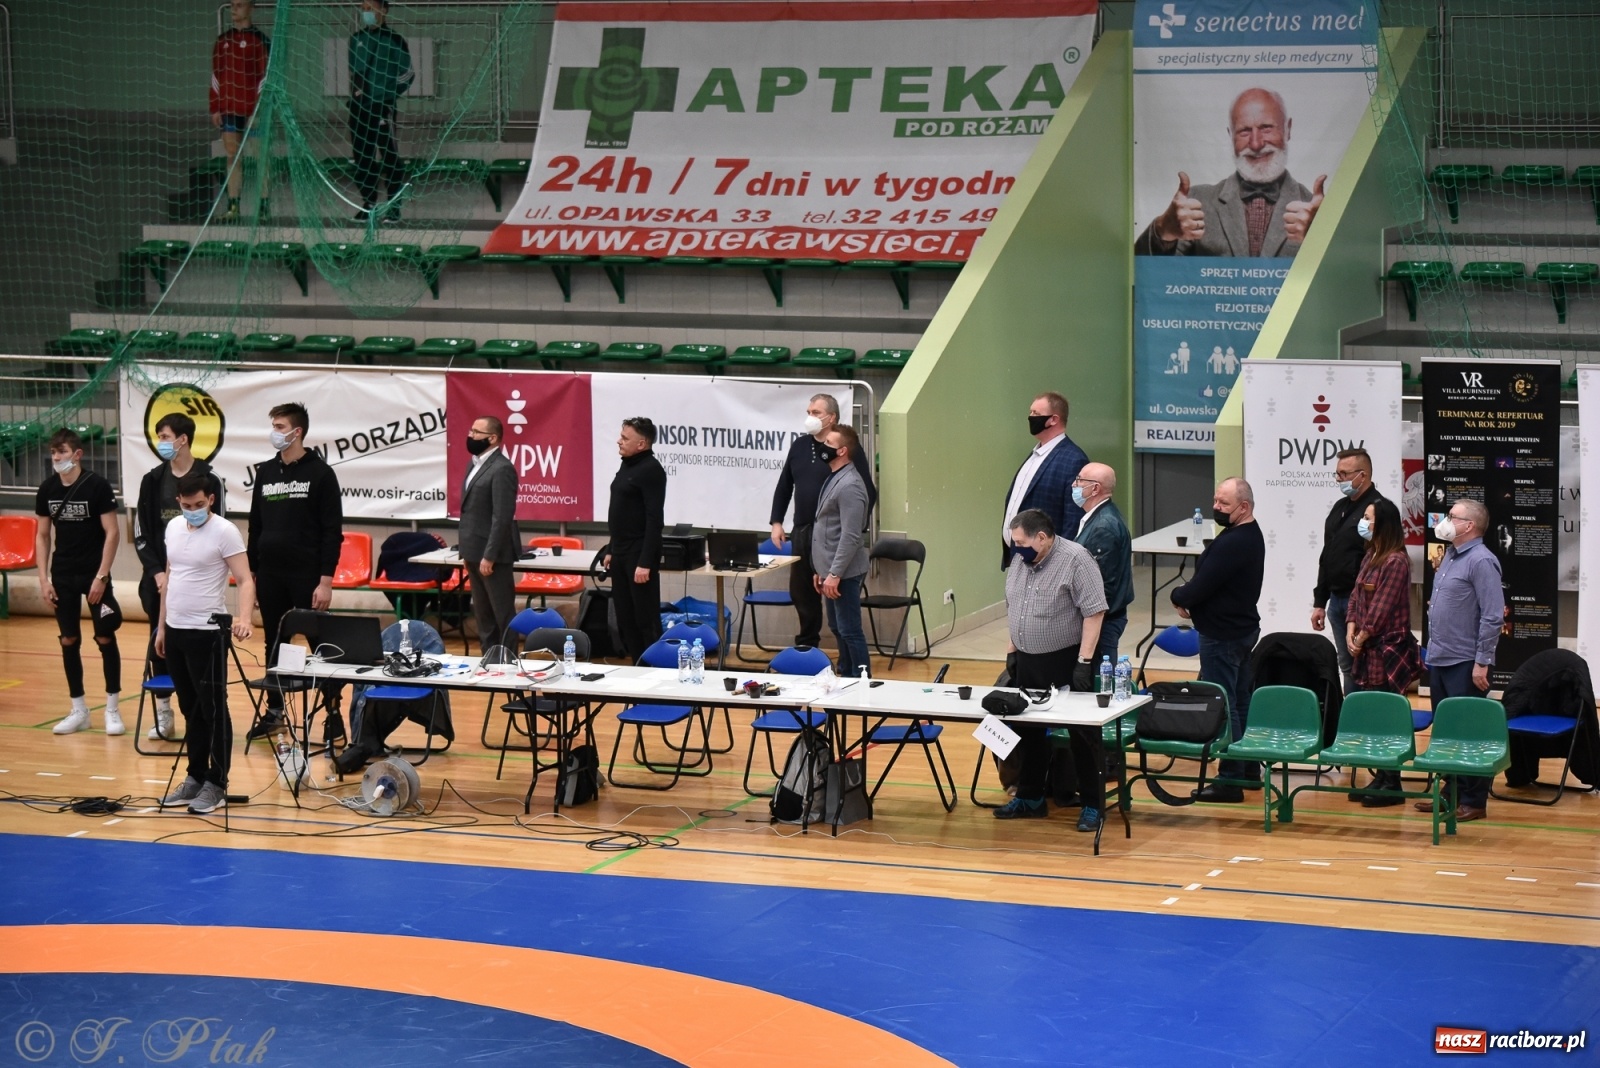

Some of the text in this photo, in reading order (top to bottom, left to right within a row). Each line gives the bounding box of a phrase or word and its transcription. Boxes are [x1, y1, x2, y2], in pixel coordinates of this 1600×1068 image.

[1194, 5, 1364, 33] senectus med
[1157, 50, 1353, 66] specjalistyczny sklep medyczny
[685, 62, 1067, 113] APTEKA
[904, 120, 955, 136] POD
[539, 155, 653, 194] 24h
[713, 158, 750, 196] 7
[745, 171, 811, 197] dni
[824, 178, 861, 197] w
[731, 209, 772, 224] 33
[889, 209, 952, 224] 415
[1200, 268, 1239, 279] SPRZĘT
[1165, 284, 1247, 296] ZAOPATRZENIE
[1142, 319, 1182, 329] USŁUGI
[1149, 403, 1218, 416] ul. Opawska
[1437, 409, 1486, 418] TERMINARZ
[1497, 411, 1544, 420] REPERTUAR
[1464, 420, 1476, 428] NA
[701, 426, 786, 451] TYTULARNY
[669, 453, 702, 465] SPONSOR
[704, 455, 758, 469] REPREZENTACJI
[1280, 470, 1312, 478] POLSKA
[1265, 479, 1305, 487] PAPIERÓW
